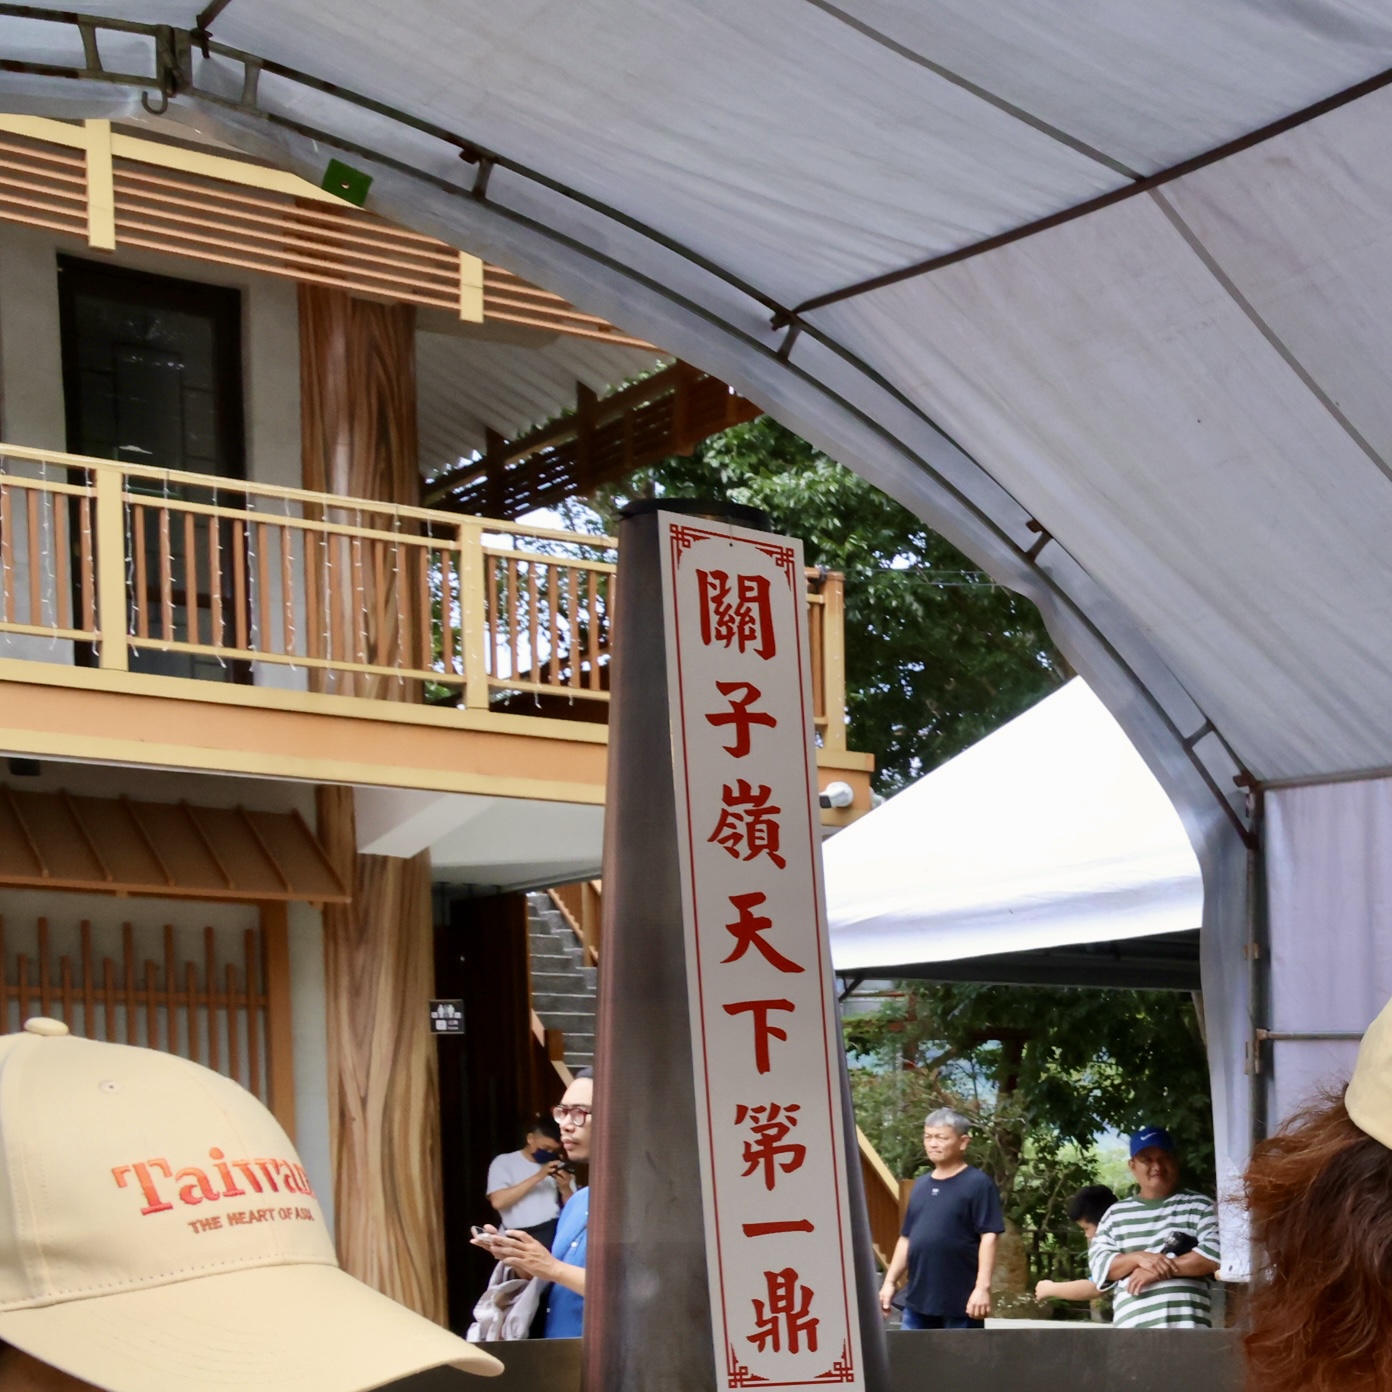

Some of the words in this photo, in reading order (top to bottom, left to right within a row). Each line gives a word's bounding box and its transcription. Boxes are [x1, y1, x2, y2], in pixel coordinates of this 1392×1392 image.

[697, 568, 818, 1356] 關子嶺天下第一鼎
[187, 1216, 223, 1234] THE
[227, 1208, 276, 1227] HEART
